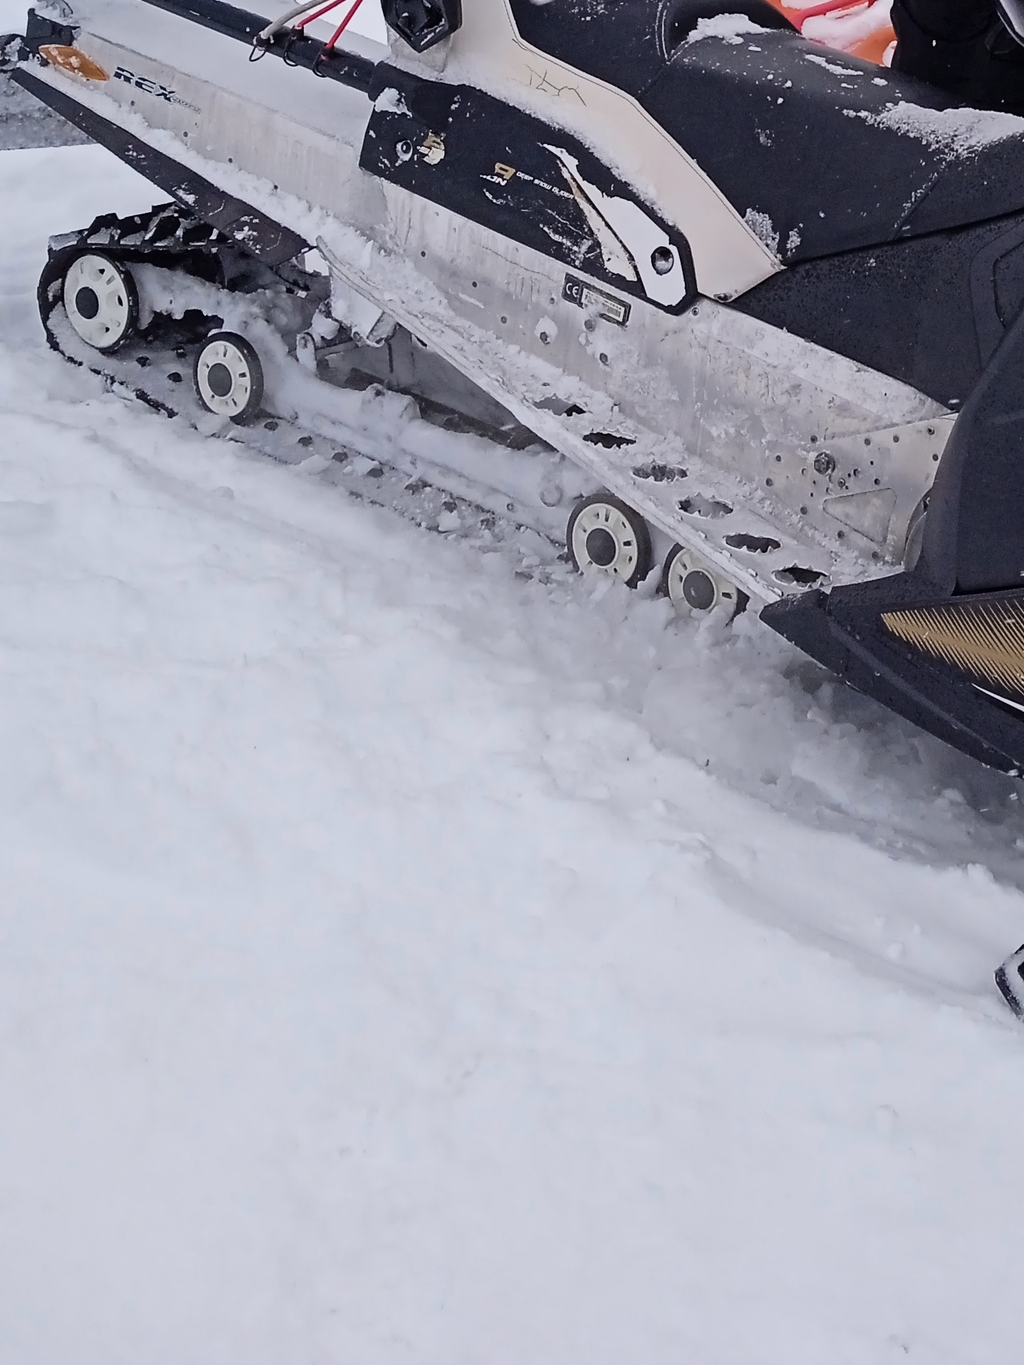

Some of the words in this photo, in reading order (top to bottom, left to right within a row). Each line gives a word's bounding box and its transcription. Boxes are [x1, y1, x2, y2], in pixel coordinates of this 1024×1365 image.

[113, 66, 176, 103] REX
[516, 171, 534, 181] DEEP
[533, 178, 552, 190] SNOW
[551, 186, 575, 199] GLIDER
